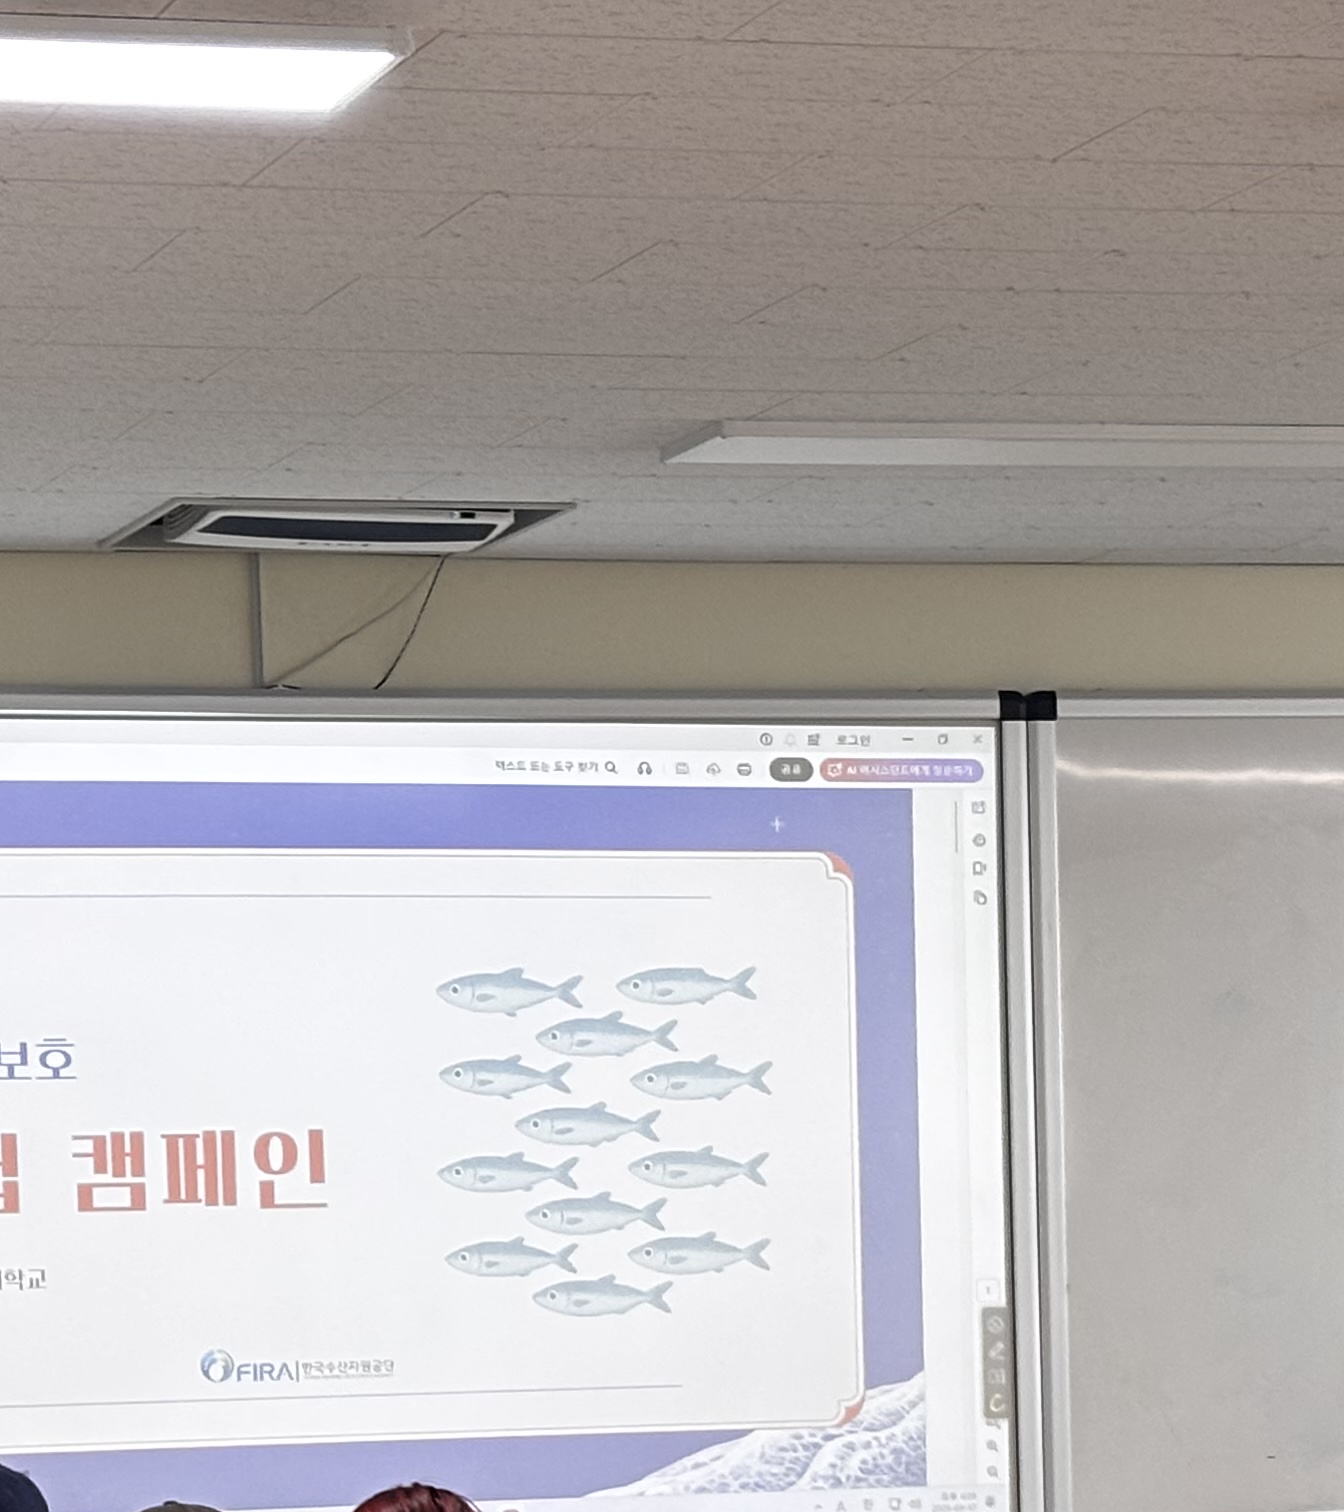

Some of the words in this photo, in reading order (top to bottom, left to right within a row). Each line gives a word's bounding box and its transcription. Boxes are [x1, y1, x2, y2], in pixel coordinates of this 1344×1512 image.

[836, 735, 871, 747] 로그인
[846, 765, 858, 775] AI
[71, 1128, 329, 1213] 캠페인
[236, 1362, 294, 1383] FIRA
[302, 1359, 395, 1375] 한국수산자원공단
